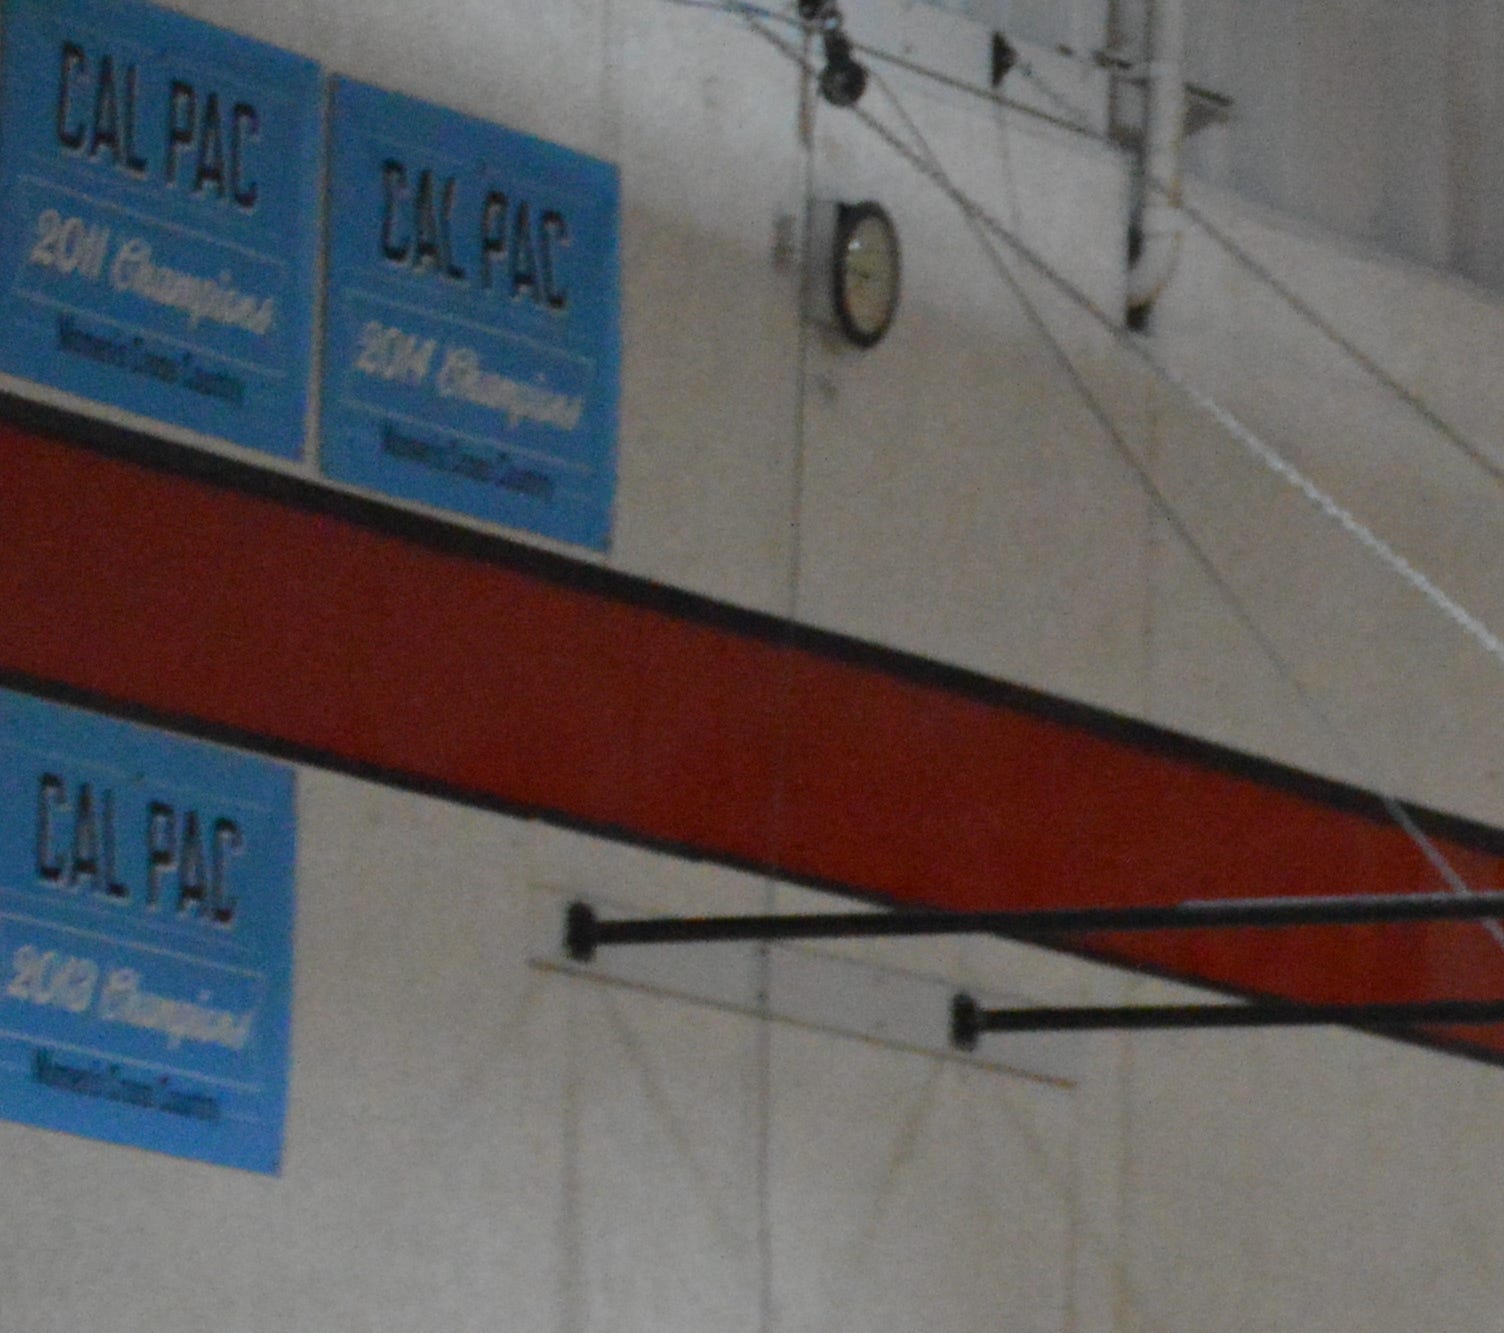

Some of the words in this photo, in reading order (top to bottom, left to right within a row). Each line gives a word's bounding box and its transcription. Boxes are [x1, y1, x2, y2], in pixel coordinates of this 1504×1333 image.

[55, 40, 147, 174] CAL
[163, 76, 260, 211] PAC
[380, 157, 467, 282] CAL
[479, 190, 572, 312] PAC
[36, 770, 131, 902] CAL
[145, 800, 245, 928] PAC
